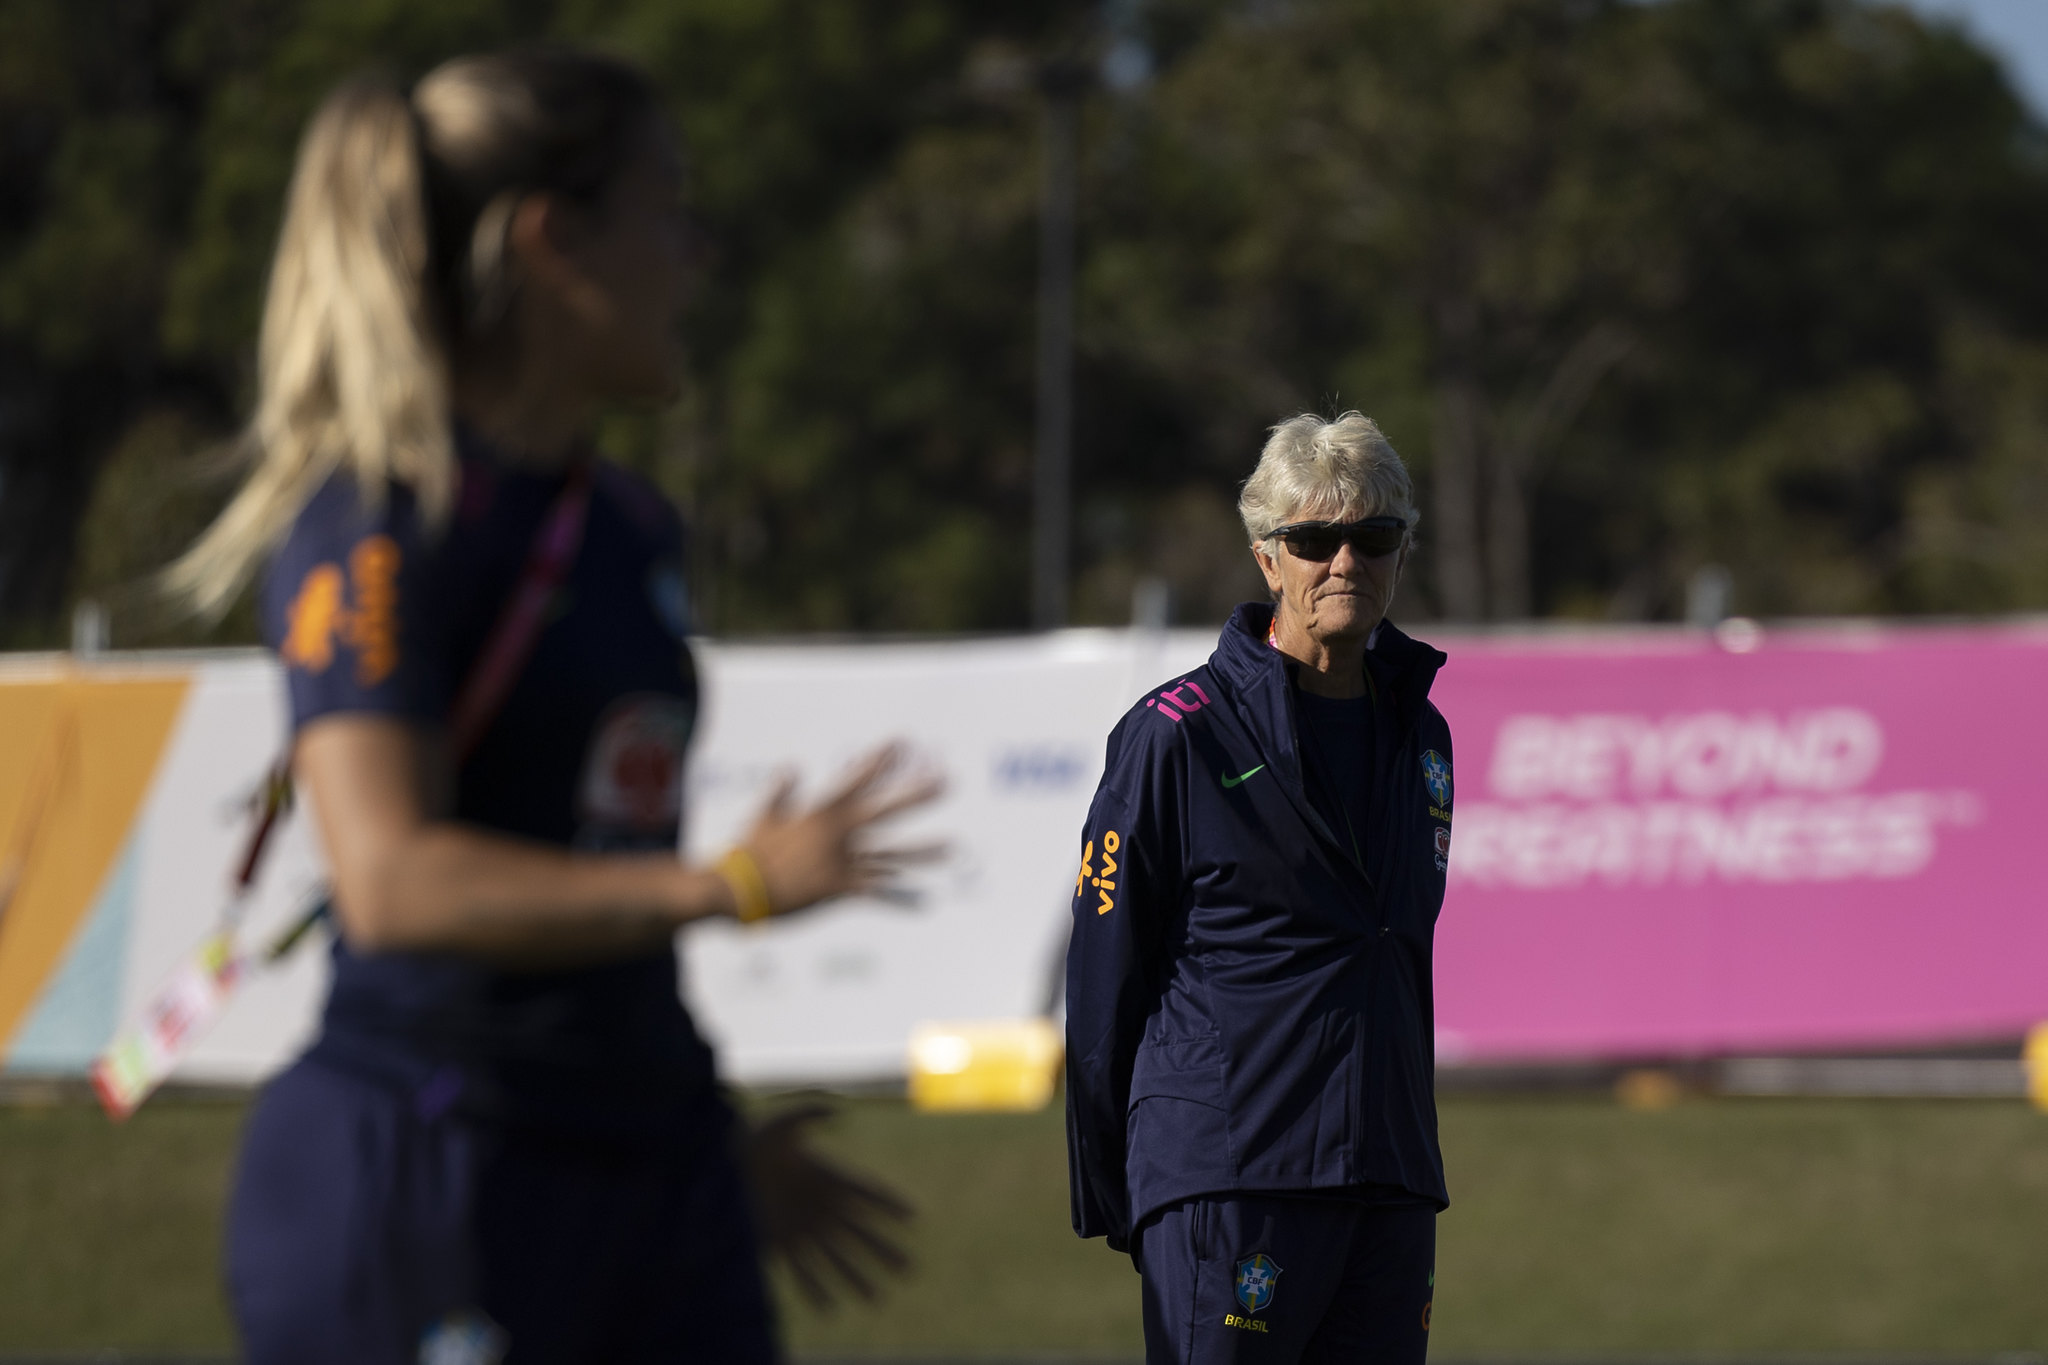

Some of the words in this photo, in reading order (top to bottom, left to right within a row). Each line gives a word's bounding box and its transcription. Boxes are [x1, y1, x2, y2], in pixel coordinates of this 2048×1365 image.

[1491, 708, 1883, 798] BEYOND
[1428, 805, 1452, 823] BRASI
[1448, 796, 1934, 886] REATNESS
[1092, 830, 1120, 915] vivo
[1247, 1276, 1264, 1286] CBF
[1225, 1313, 1269, 1333] BRASIL
